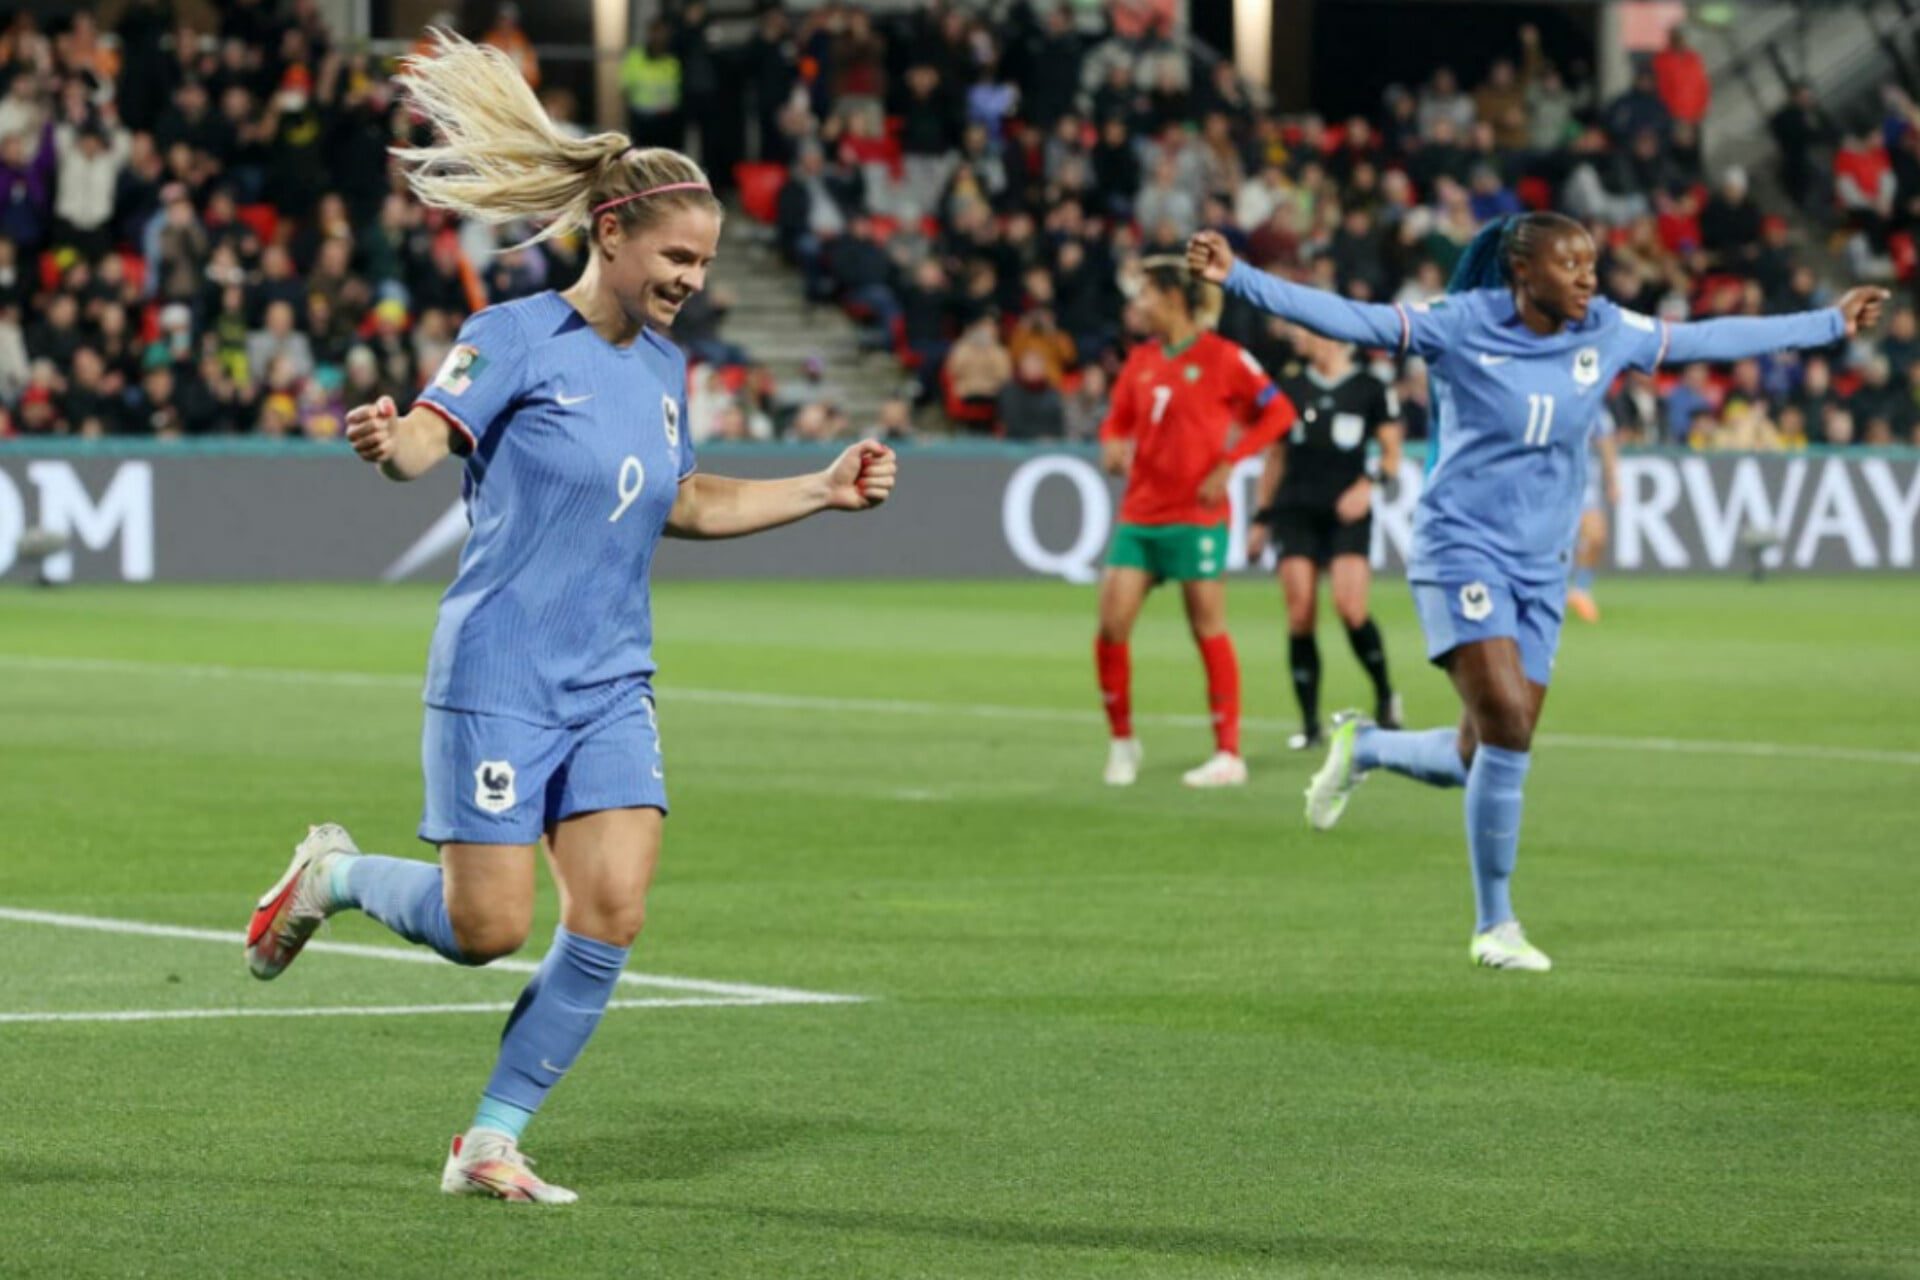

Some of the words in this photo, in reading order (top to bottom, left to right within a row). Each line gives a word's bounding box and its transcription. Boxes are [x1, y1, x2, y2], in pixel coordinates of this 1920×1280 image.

[1152, 385, 1173, 425] 7
[1523, 393, 1554, 446] 11
[608, 455, 644, 522] 9
[0, 460, 153, 581] M
